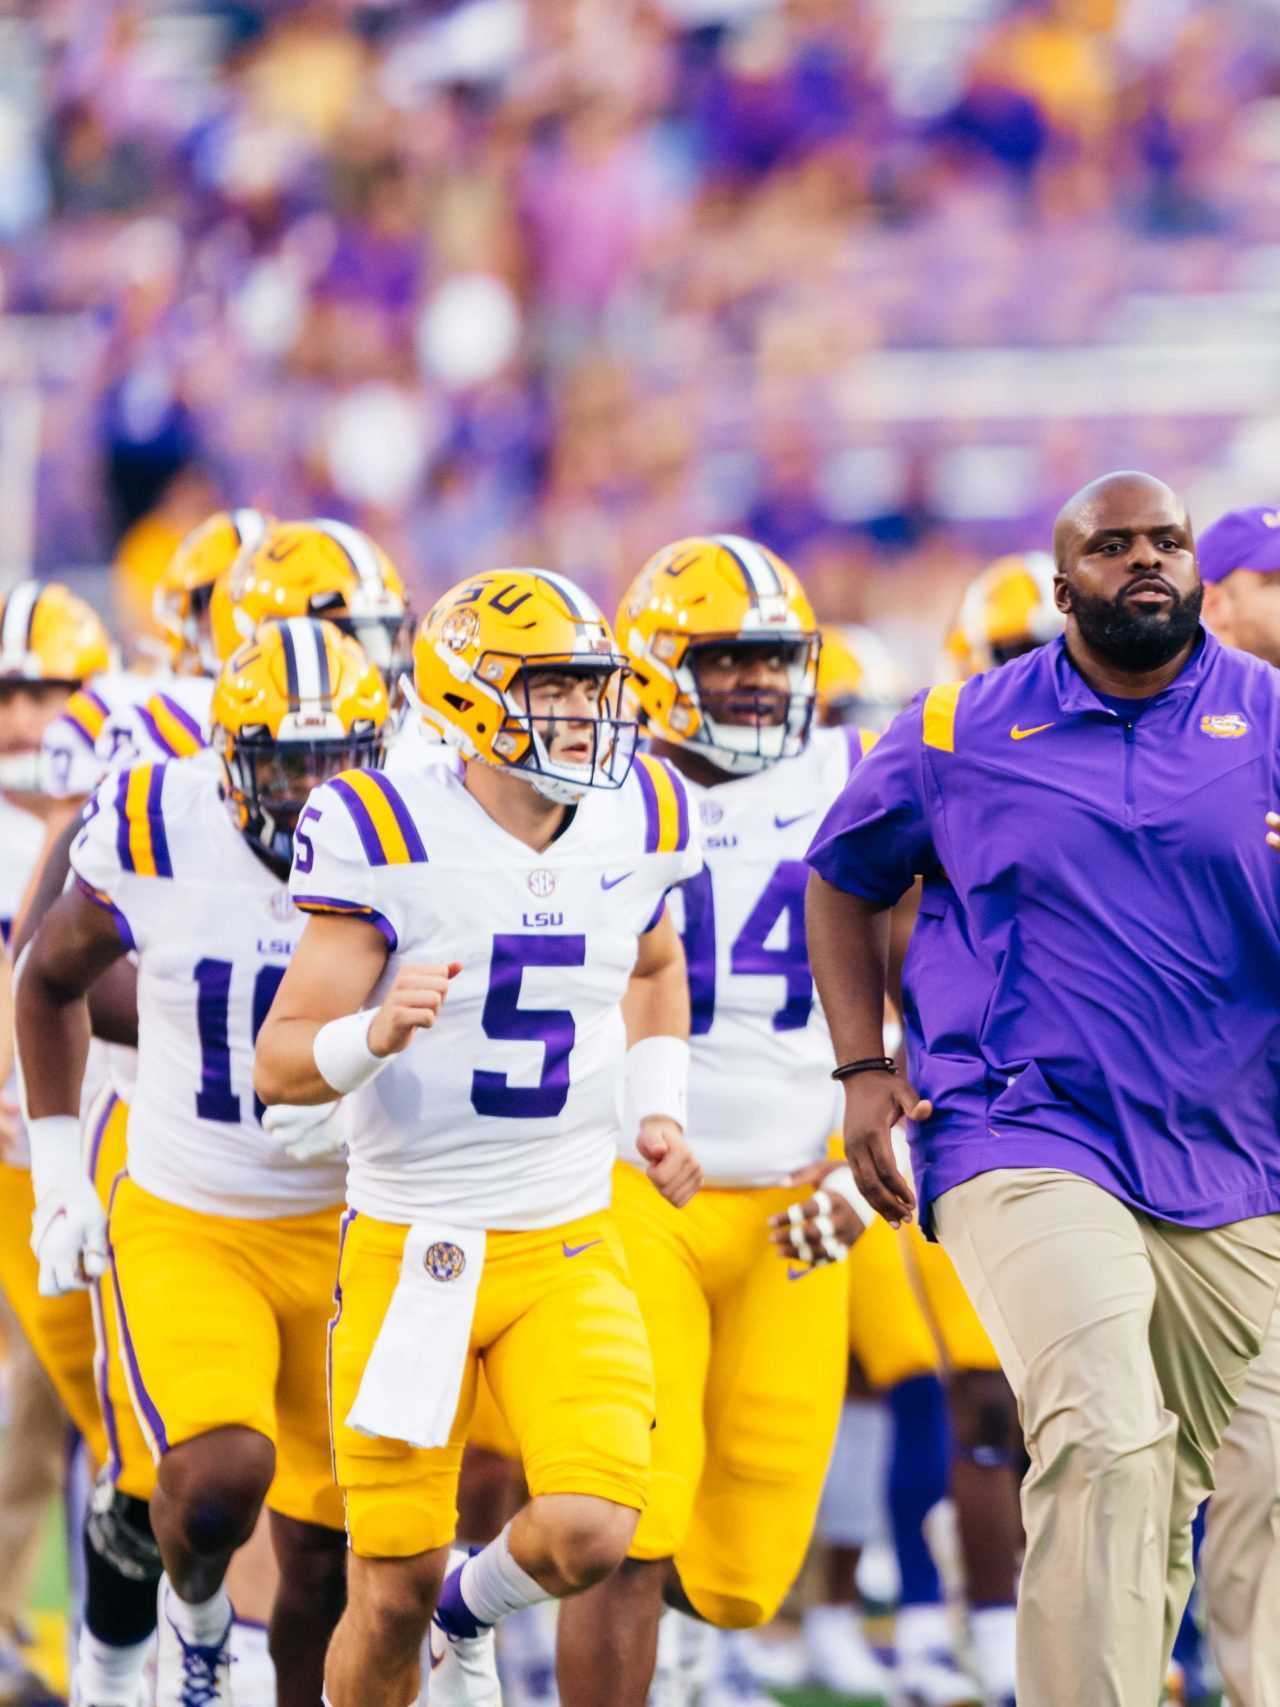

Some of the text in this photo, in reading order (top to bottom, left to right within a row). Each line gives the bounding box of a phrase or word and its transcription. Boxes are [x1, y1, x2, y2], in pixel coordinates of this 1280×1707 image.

[295, 806, 322, 874] 5
[522, 911, 564, 928] LSU
[470, 933, 587, 1119] 5
